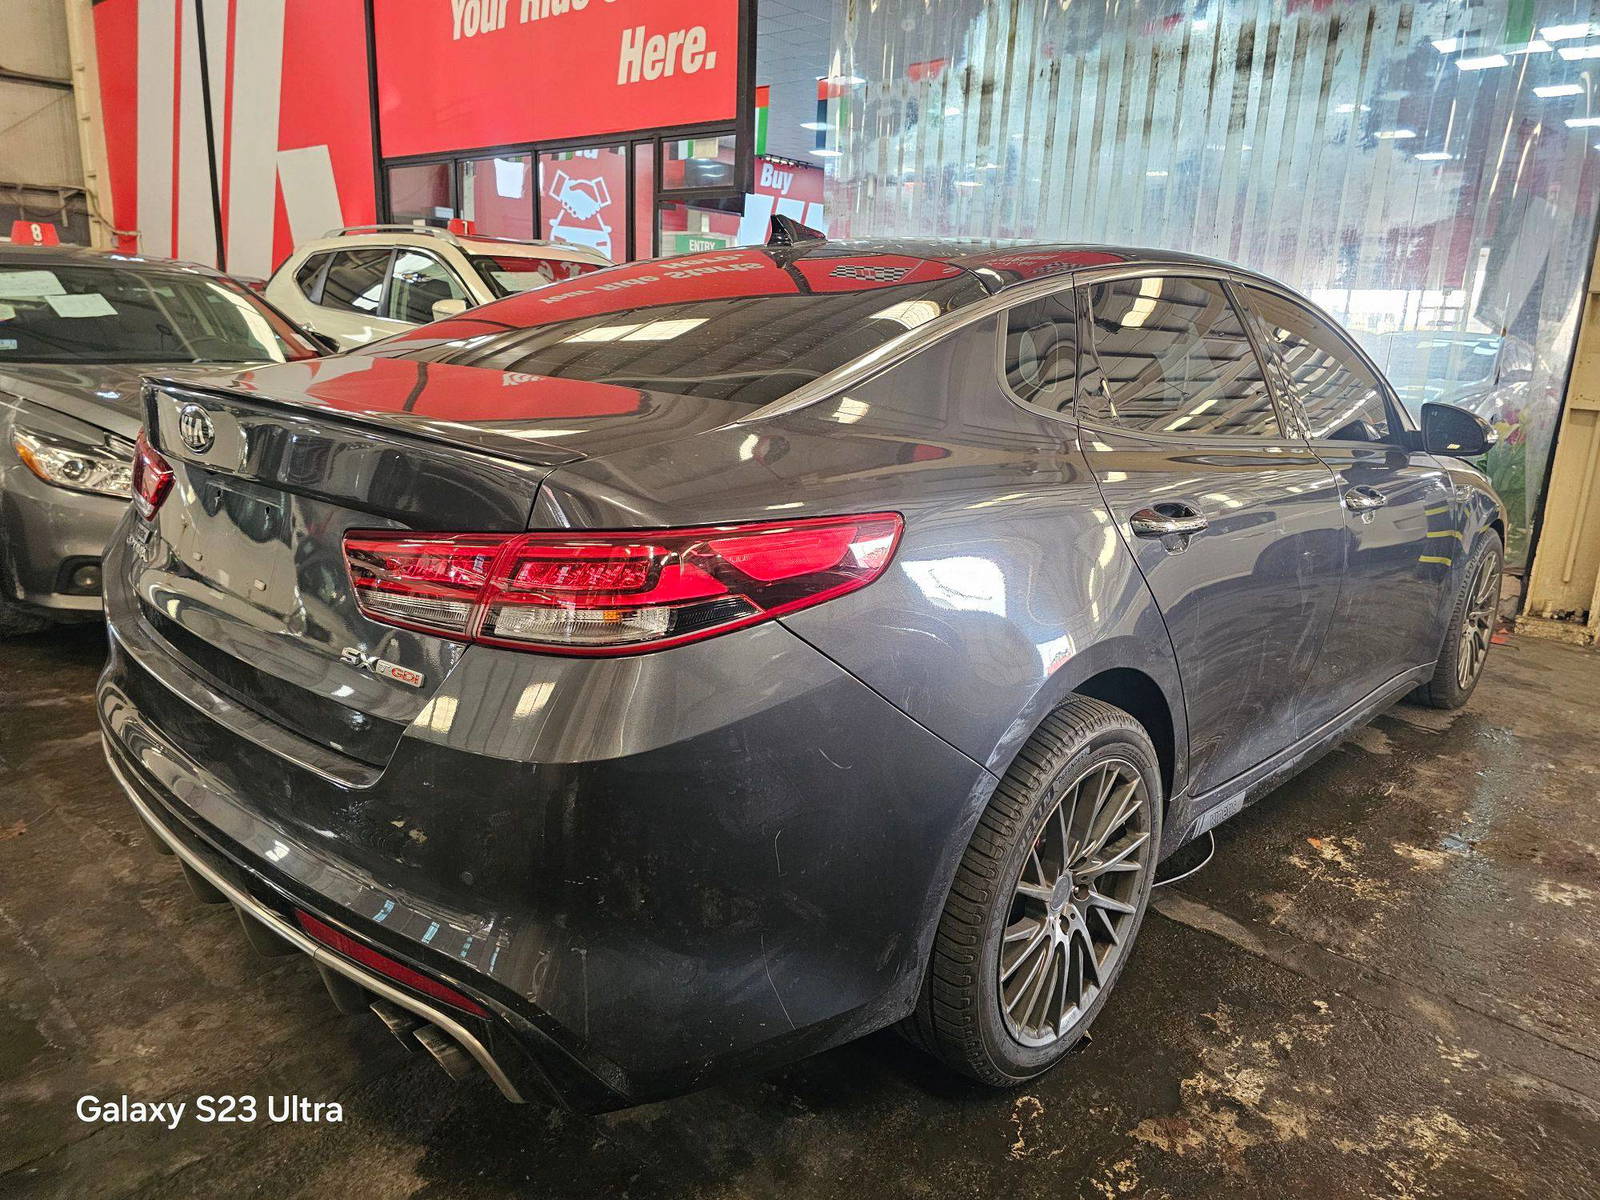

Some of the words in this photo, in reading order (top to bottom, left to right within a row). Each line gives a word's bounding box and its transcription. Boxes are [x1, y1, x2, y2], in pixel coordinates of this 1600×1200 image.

[451, 0, 508, 41] Your
[617, 25, 717, 85] Here.
[760, 163, 793, 195] Buy
[30, 223, 43, 242] 8
[688, 239, 716, 252] ENTRY
[340, 647, 380, 673] SX
